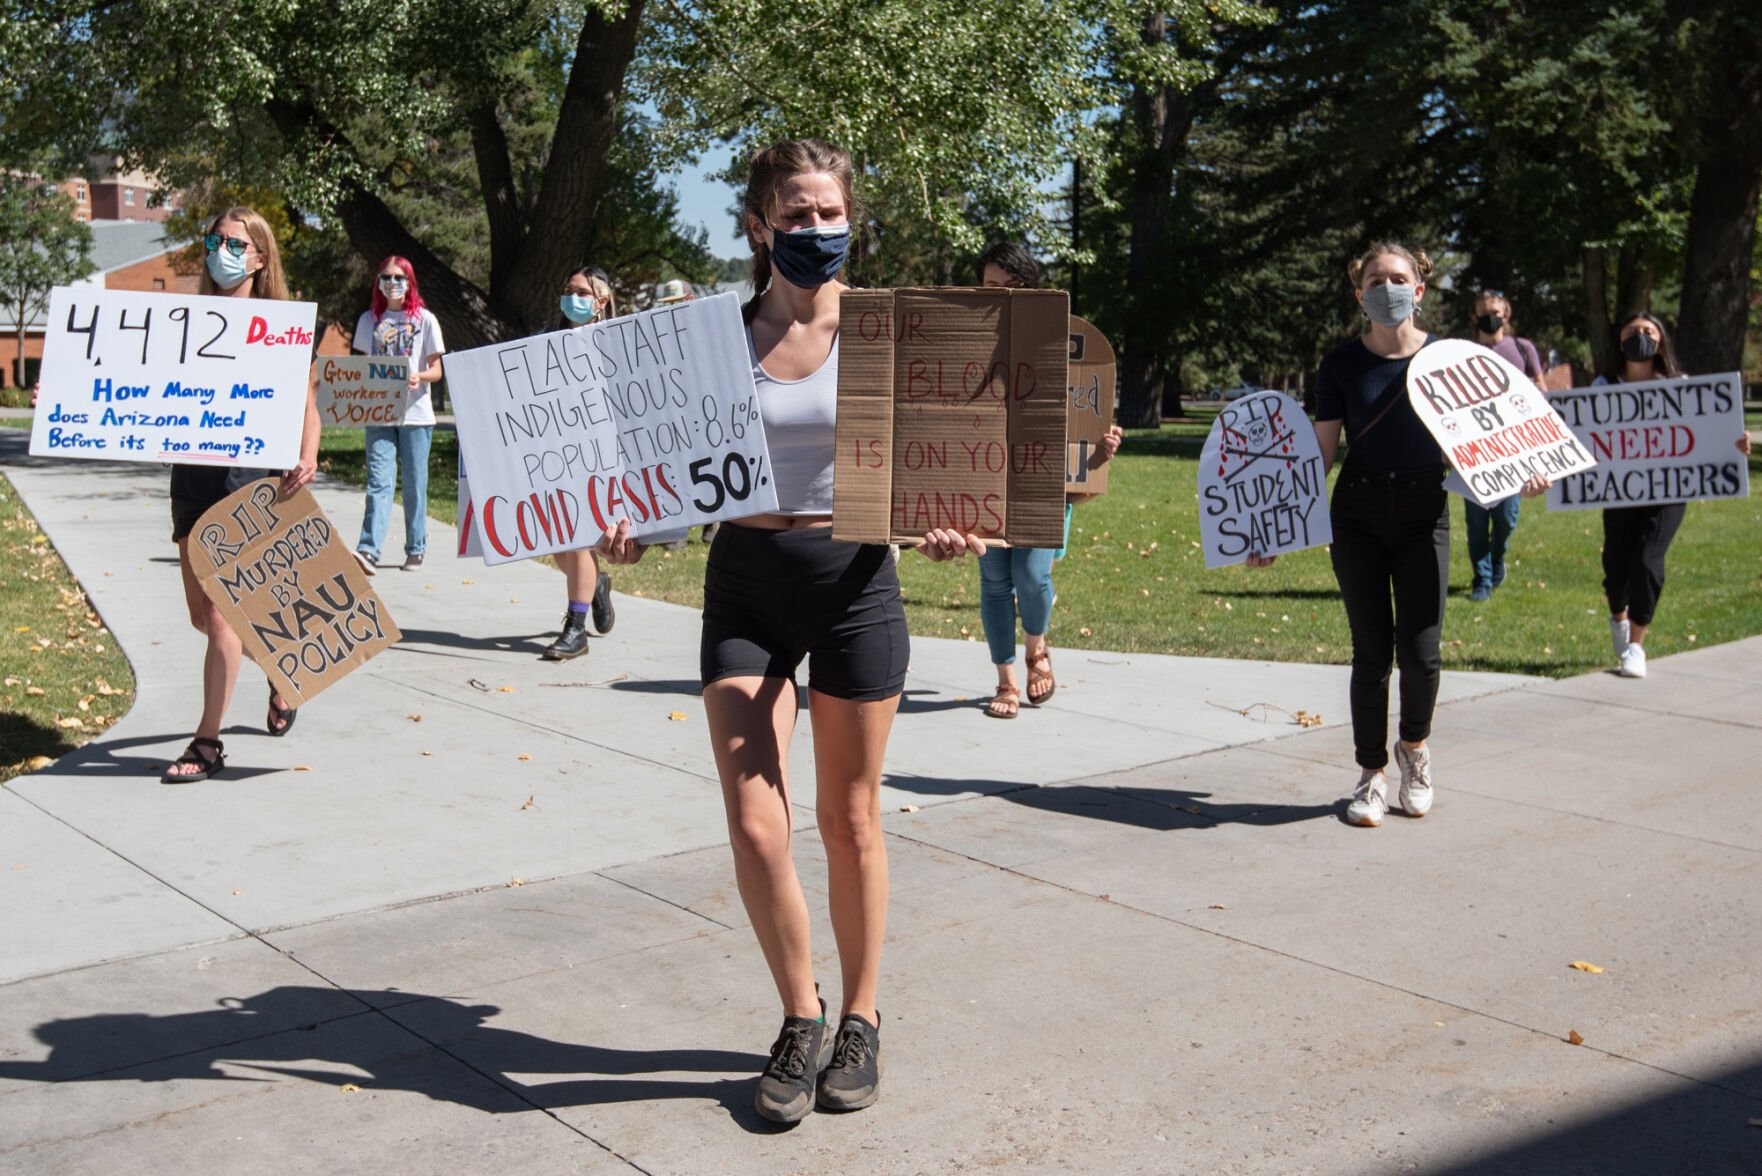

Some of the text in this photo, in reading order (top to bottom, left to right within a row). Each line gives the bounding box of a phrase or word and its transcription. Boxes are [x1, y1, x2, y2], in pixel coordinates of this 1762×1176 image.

[67, 303, 313, 367] 4,492 Deaths
[858, 311, 932, 344] OUR
[324, 360, 407, 384] Give NAU
[498, 304, 690, 400] FLAGSTAFF
[92, 378, 275, 404] How Many More
[333, 384, 401, 400] workers a
[908, 359, 1037, 401] BLOOD
[1415, 355, 1510, 415] KILLED
[48, 404, 246, 428] does Arizona Need
[327, 402, 399, 424] VOICE
[496, 368, 688, 447] INDIGENOUS
[1218, 395, 1282, 445] RIP
[1470, 401, 1504, 431] BY
[48, 427, 107, 449] Before
[120, 433, 145, 450] its
[162, 437, 191, 452] too
[855, 439, 883, 469] IS
[904, 441, 947, 471] ON
[961, 441, 1052, 475] YOUR
[1452, 412, 1568, 471] ADMINISTRATIVE
[1589, 425, 1695, 462] NEED
[1204, 456, 1320, 516] STUDENT
[1470, 439, 1587, 496] COMPLACENCY
[1560, 462, 1741, 505] TEACHERS
[200, 482, 280, 568] RIP
[483, 487, 580, 557] COVID
[587, 462, 684, 532] CASES:
[689, 452, 768, 514] 50%
[890, 492, 1004, 535] HANDS
[1218, 497, 1316, 556] SAFETY
[215, 516, 331, 605] MURDERED
[270, 569, 305, 608] BY
[250, 572, 355, 653] NAU
[277, 598, 386, 692] POLICY
